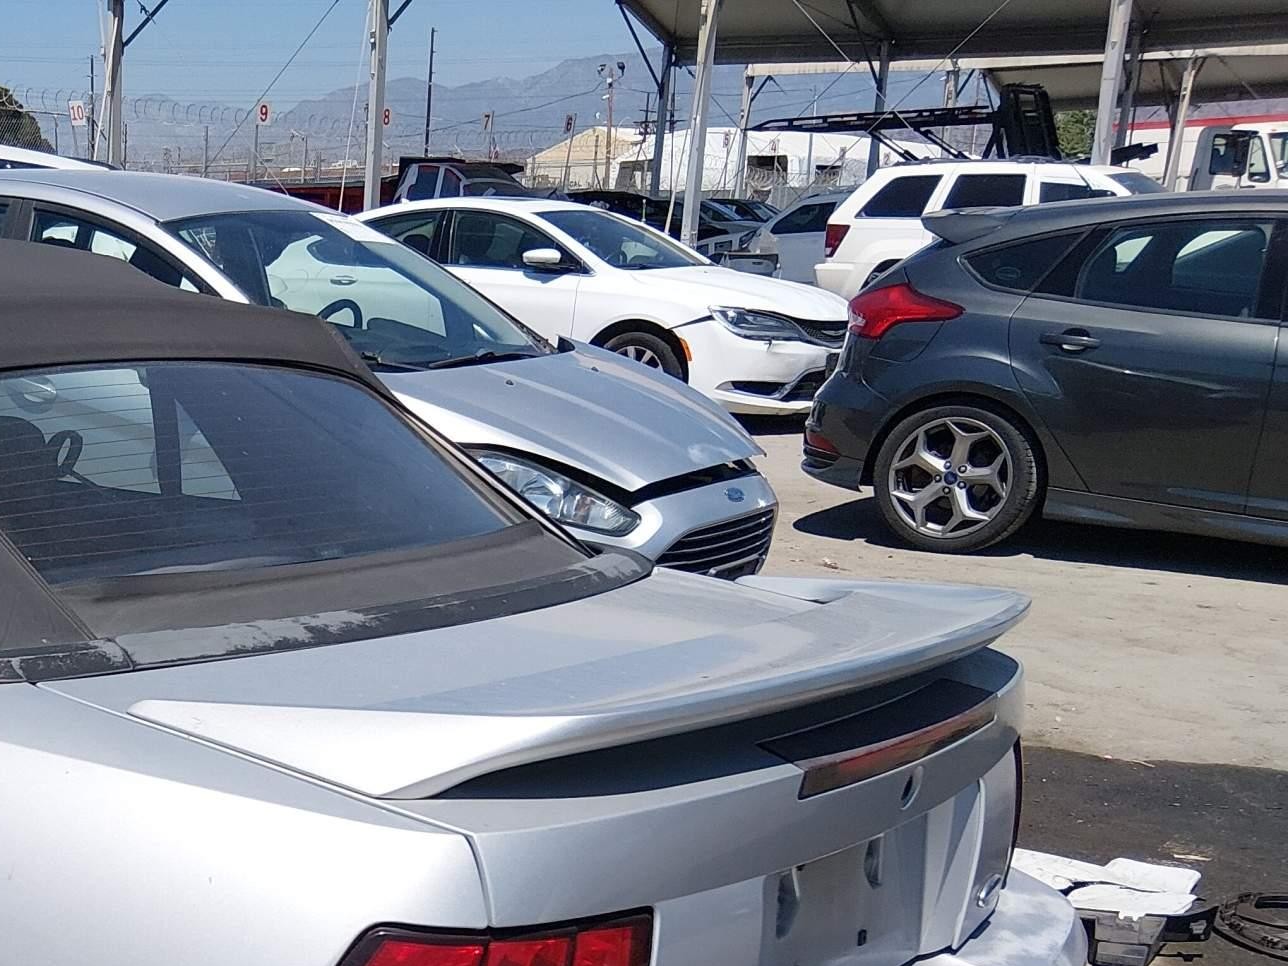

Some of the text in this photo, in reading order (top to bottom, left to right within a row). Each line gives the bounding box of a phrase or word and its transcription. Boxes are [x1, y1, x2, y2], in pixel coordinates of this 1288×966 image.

[70, 106, 84, 121] 10
[259, 104, 269, 122] 9
[383, 108, 391, 126] 8
[483, 114, 490, 130] 7
